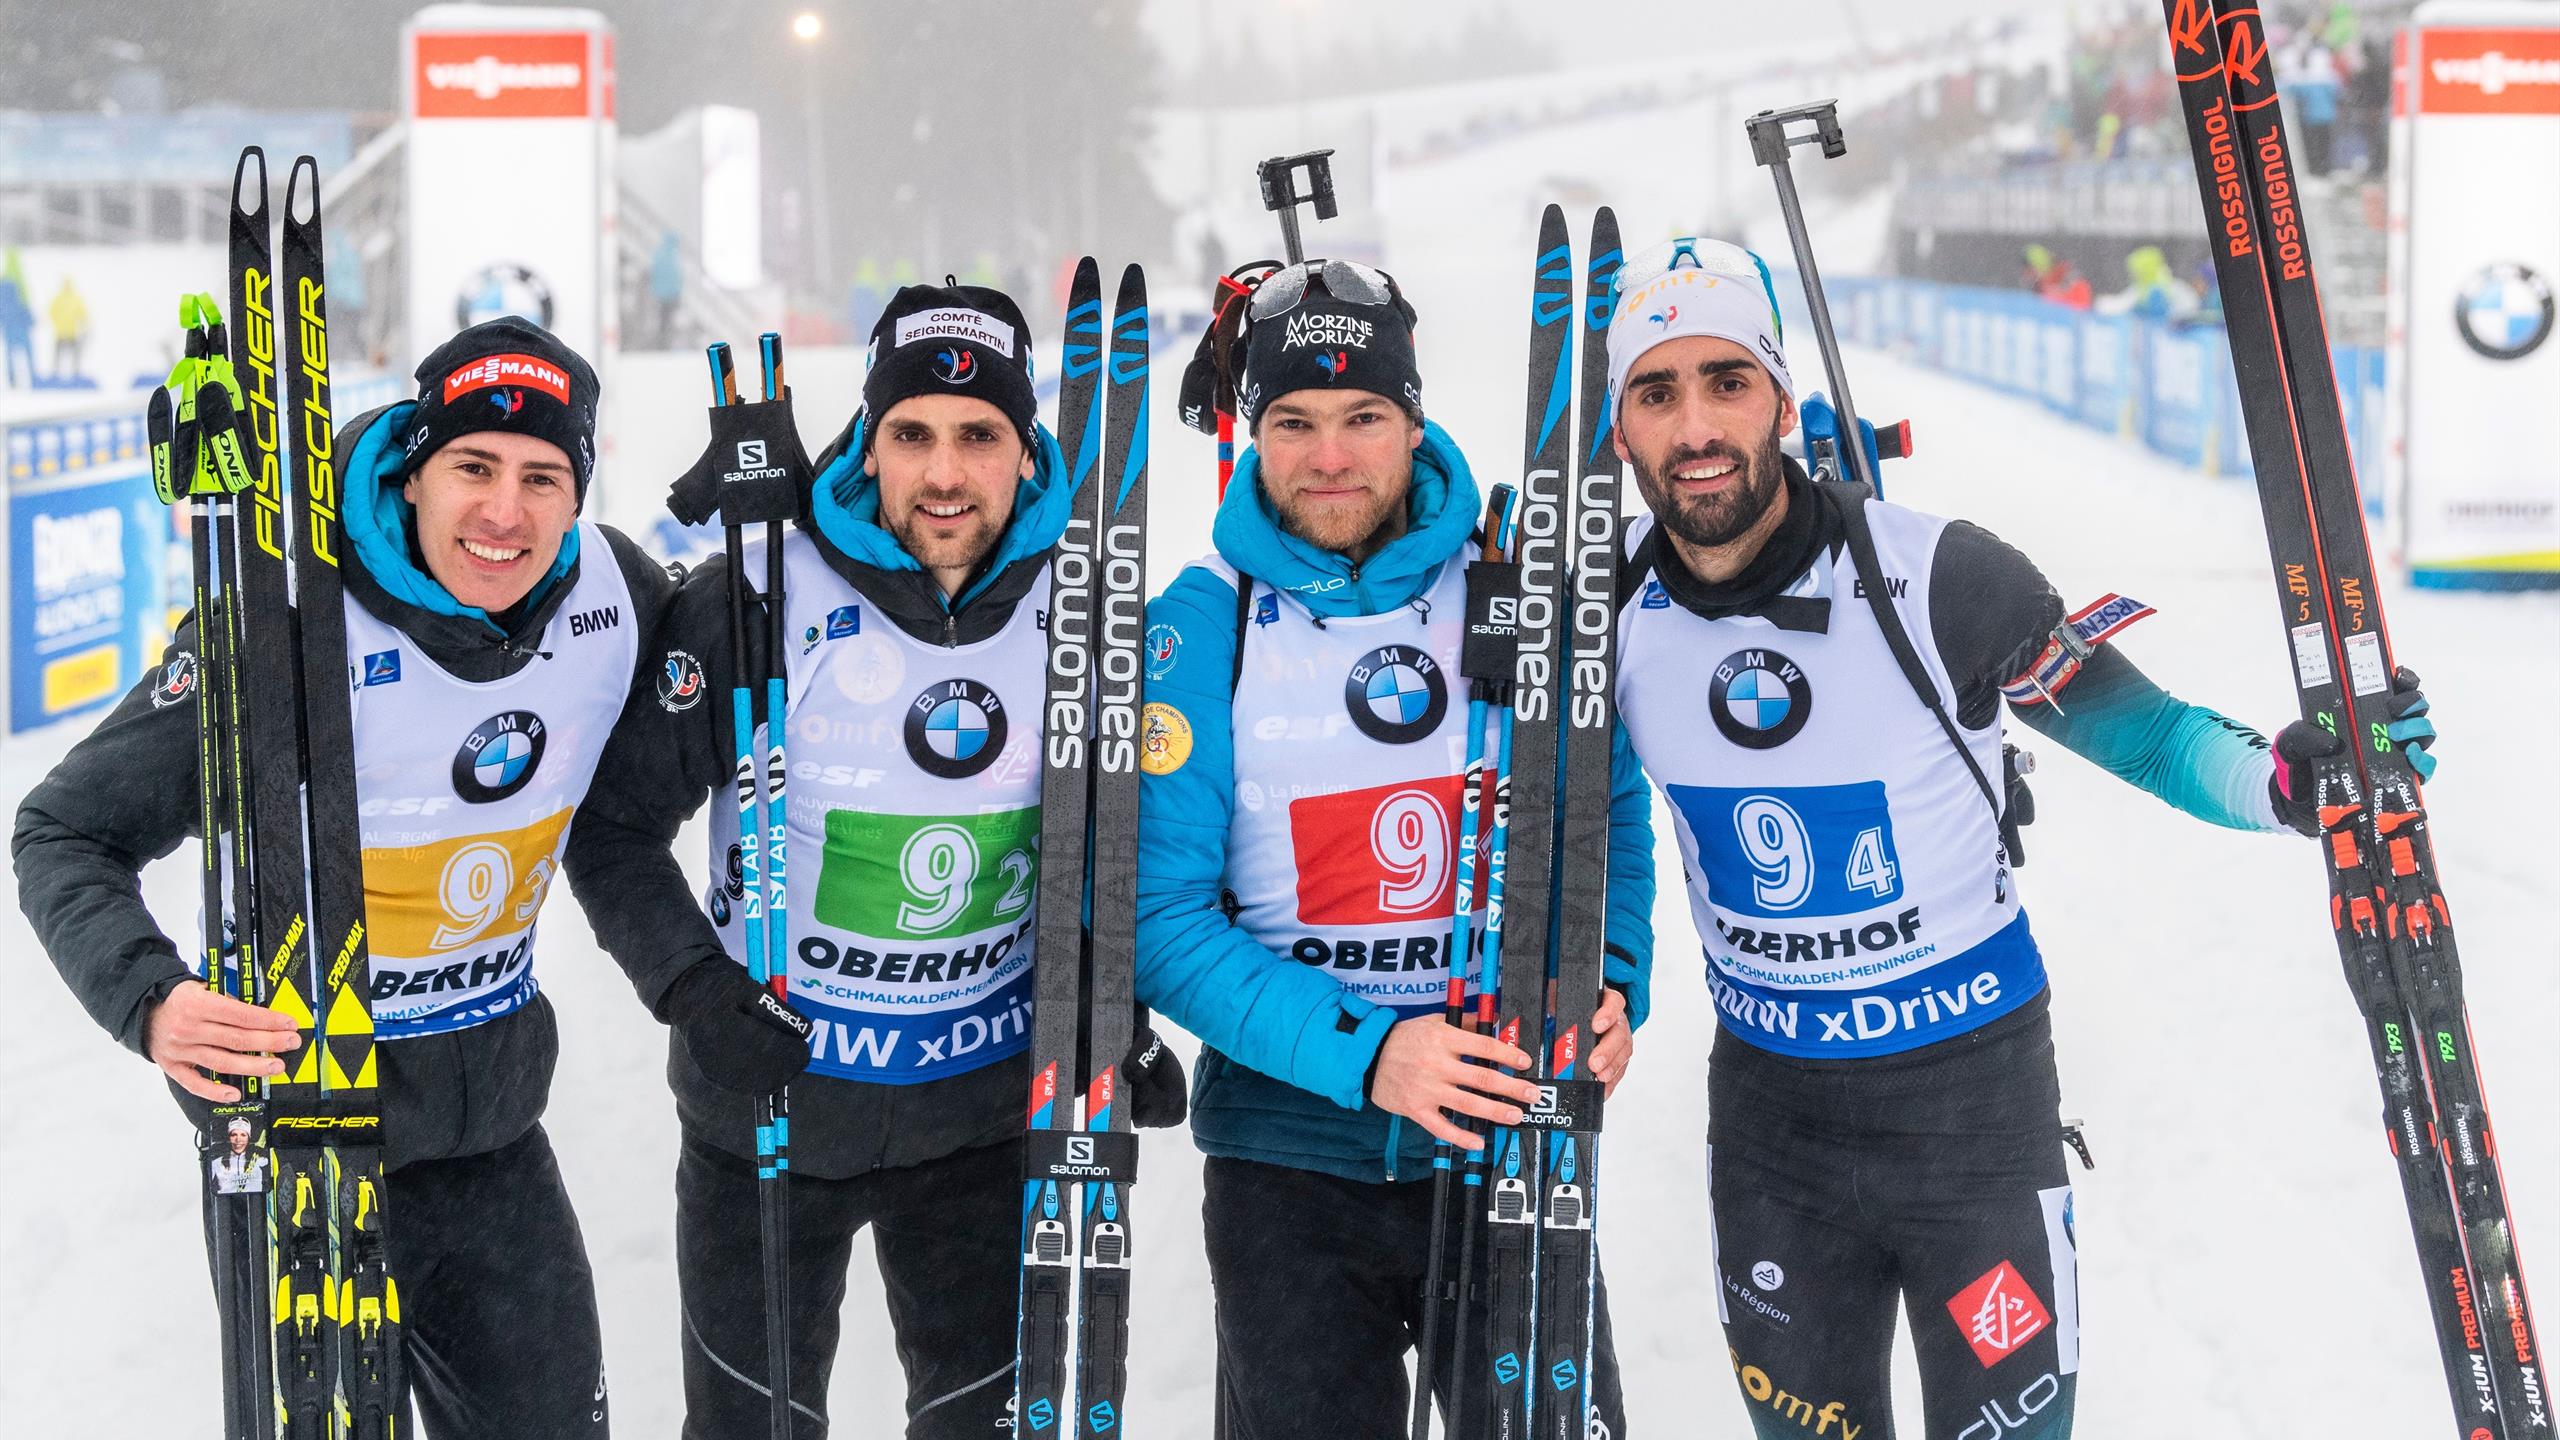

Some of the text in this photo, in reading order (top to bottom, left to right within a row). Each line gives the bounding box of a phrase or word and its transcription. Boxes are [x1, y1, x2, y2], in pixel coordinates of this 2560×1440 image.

[2203, 96, 2253, 257] ROSSIGNOL
[2258, 125, 2306, 281] ROSSIGNOL
[905, 325, 1006, 352] SEIGNEMARTIN
[930, 313, 983, 326] COMTÉ
[1282, 329, 1367, 352] AVORIAZ
[1286, 311, 1373, 337] MORZINE
[450, 358, 565, 390] VIESSMANN
[245, 267, 283, 560] FISCHER
[299, 276, 338, 568] FISCHER
[723, 468, 786, 482] salomon
[1515, 469, 1560, 722] salomon
[1572, 474, 1614, 729] salomon
[1853, 577, 1909, 599] BW
[2285, 563, 2310, 622] MF 5
[2340, 577, 2366, 632] MF 5
[570, 606, 620, 637] BMW
[1049, 519, 1091, 769] salomon
[1101, 524, 1140, 773] salomon
[1351, 647, 1436, 685] BMW
[1716, 651, 1801, 684] BMW
[915, 681, 1001, 714] BMW
[1155, 706, 1188, 734] CHAMPIONS
[465, 713, 543, 753] BMW
[2371, 722, 2391, 753] S2
[1370, 788, 1452, 914] 9
[1732, 794, 1897, 911] 9 4
[429, 841, 514, 950] 9
[896, 822, 1033, 934] 9 2
[267, 943, 291, 986] SPEED
[285, 913, 306, 951] MAX
[327, 949, 352, 992] SPEED
[345, 919, 365, 957] MAX
[1735, 942, 1936, 985] SCHMALKALDEN-MEININGEN
[805, 994, 1033, 1068] MW xDriv
[1815, 970, 2002, 1042] xDrive
[2385, 1022, 2404, 1054] 193
[2437, 1032, 2456, 1063] 193
[272, 1116, 380, 1128] FISCHER
[1521, 1113, 1572, 1127] alomon
[2402, 1105, 2421, 1156] ROSSIGNOL
[2456, 1114, 2475, 1166] ROSSIGNOL
[1050, 1165, 1110, 1176] salomon
[1725, 1273, 1740, 1294] La
[1740, 1286, 1791, 1326] Région
[2451, 1265, 2482, 1350] PREMIUM
